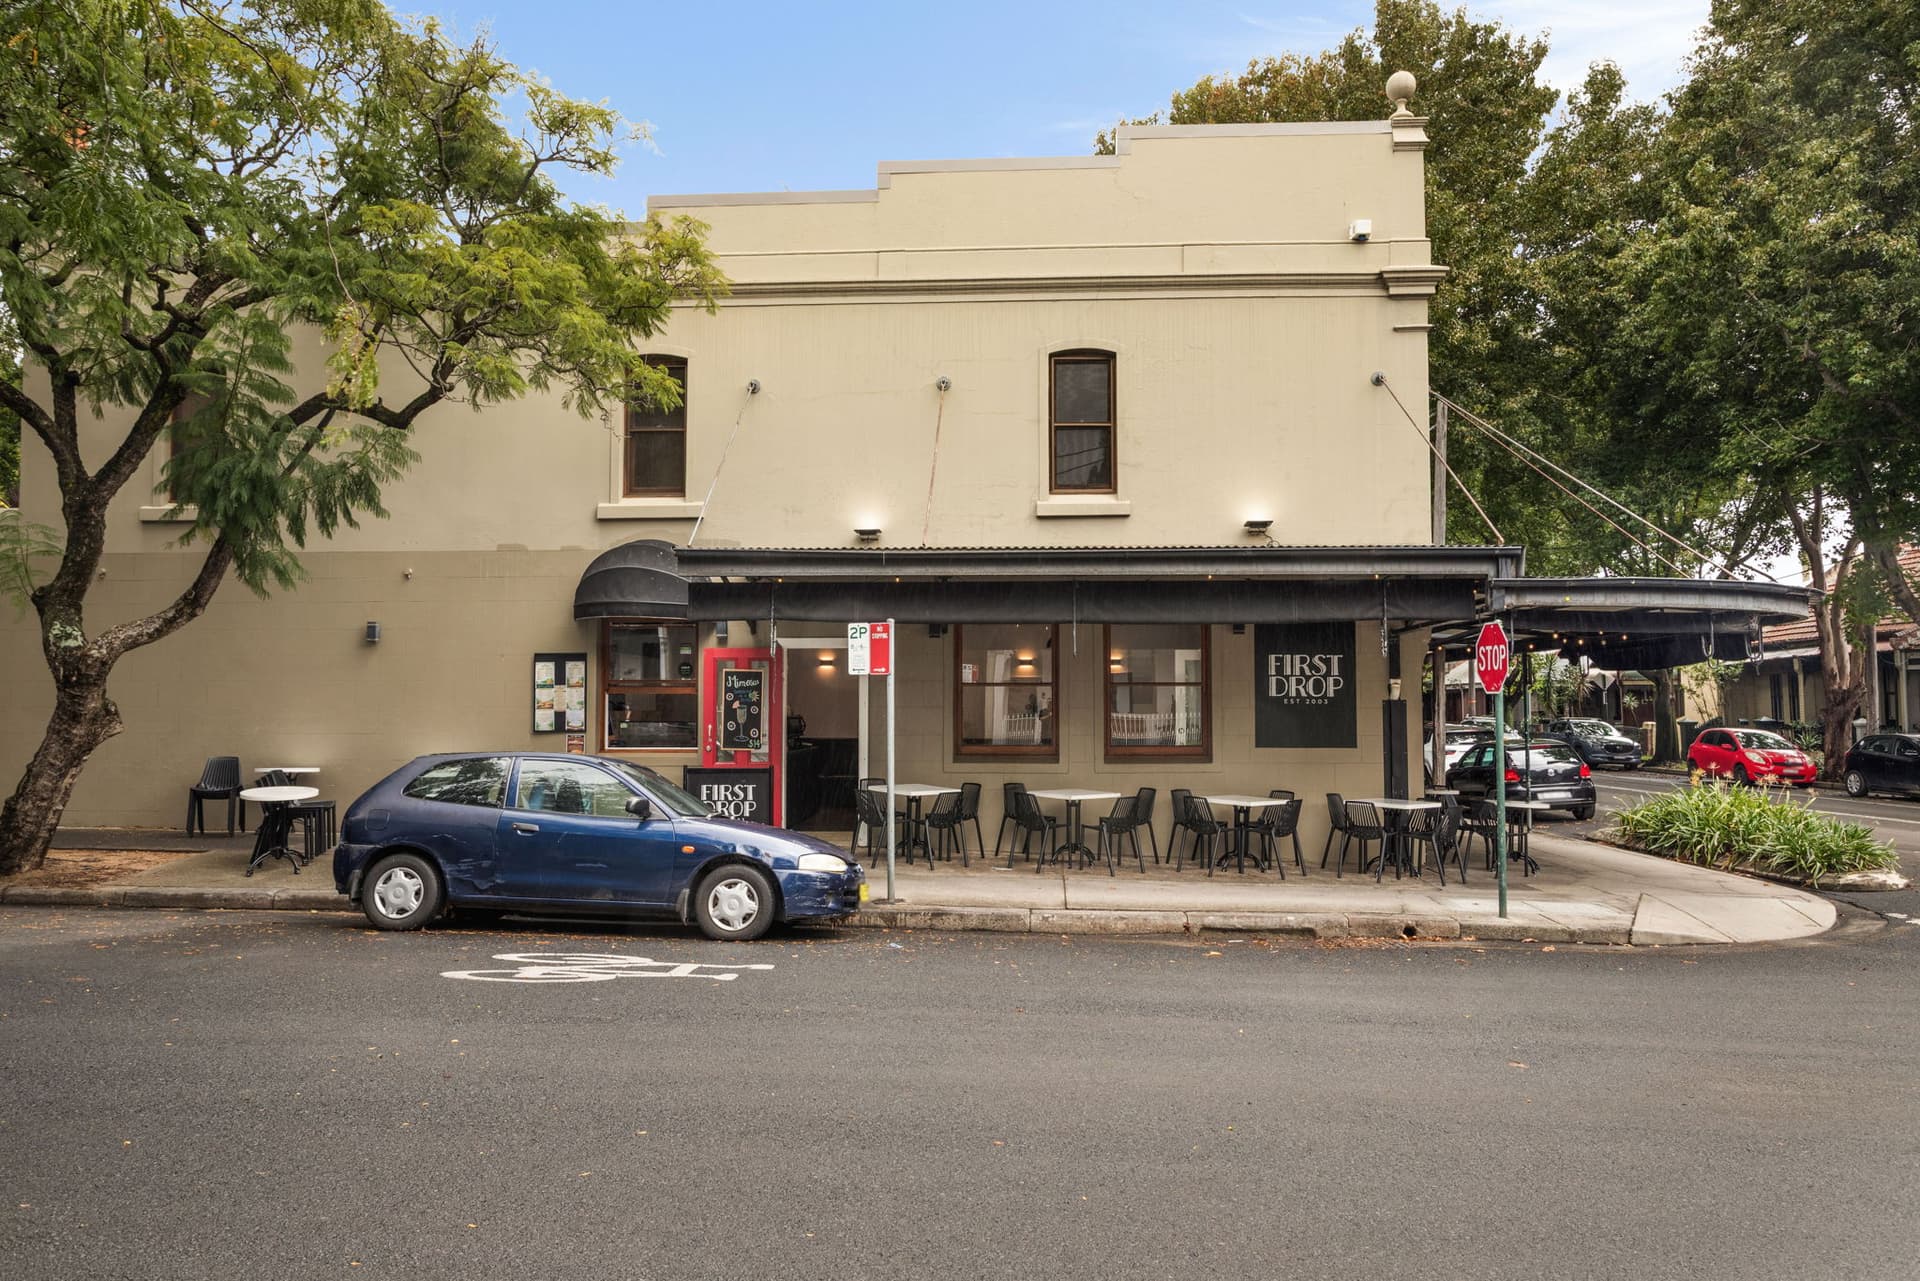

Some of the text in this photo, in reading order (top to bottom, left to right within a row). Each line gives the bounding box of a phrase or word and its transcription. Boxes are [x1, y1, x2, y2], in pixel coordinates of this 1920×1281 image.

[850, 626, 868, 639] 2P
[1268, 654, 1343, 675] FIRST
[1479, 644, 1506, 671] STOP
[1268, 676, 1344, 697] DROP
[700, 784, 757, 801] FIRST
